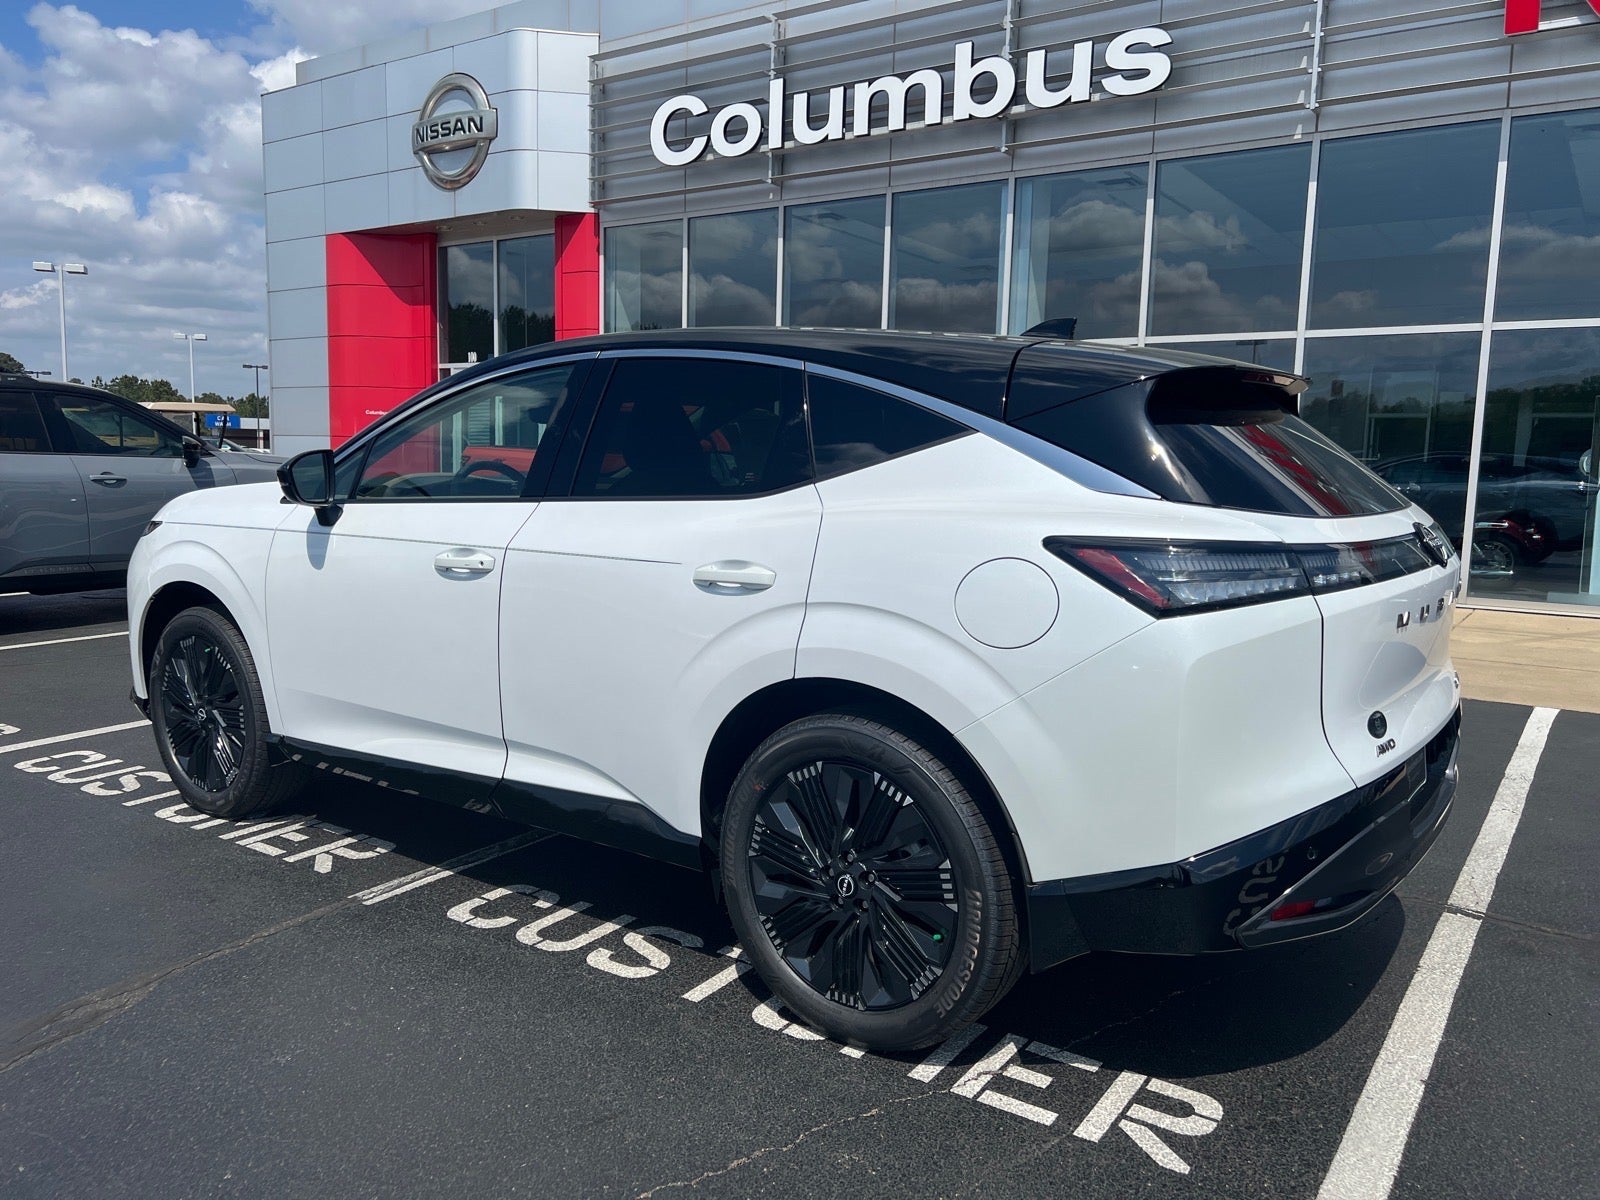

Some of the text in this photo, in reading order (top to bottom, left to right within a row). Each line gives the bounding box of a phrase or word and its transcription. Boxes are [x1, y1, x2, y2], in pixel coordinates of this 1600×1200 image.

[649, 27, 1174, 167] Columbus
[415, 116, 484, 145] NISSAN
[1375, 738, 1397, 758] AWD
